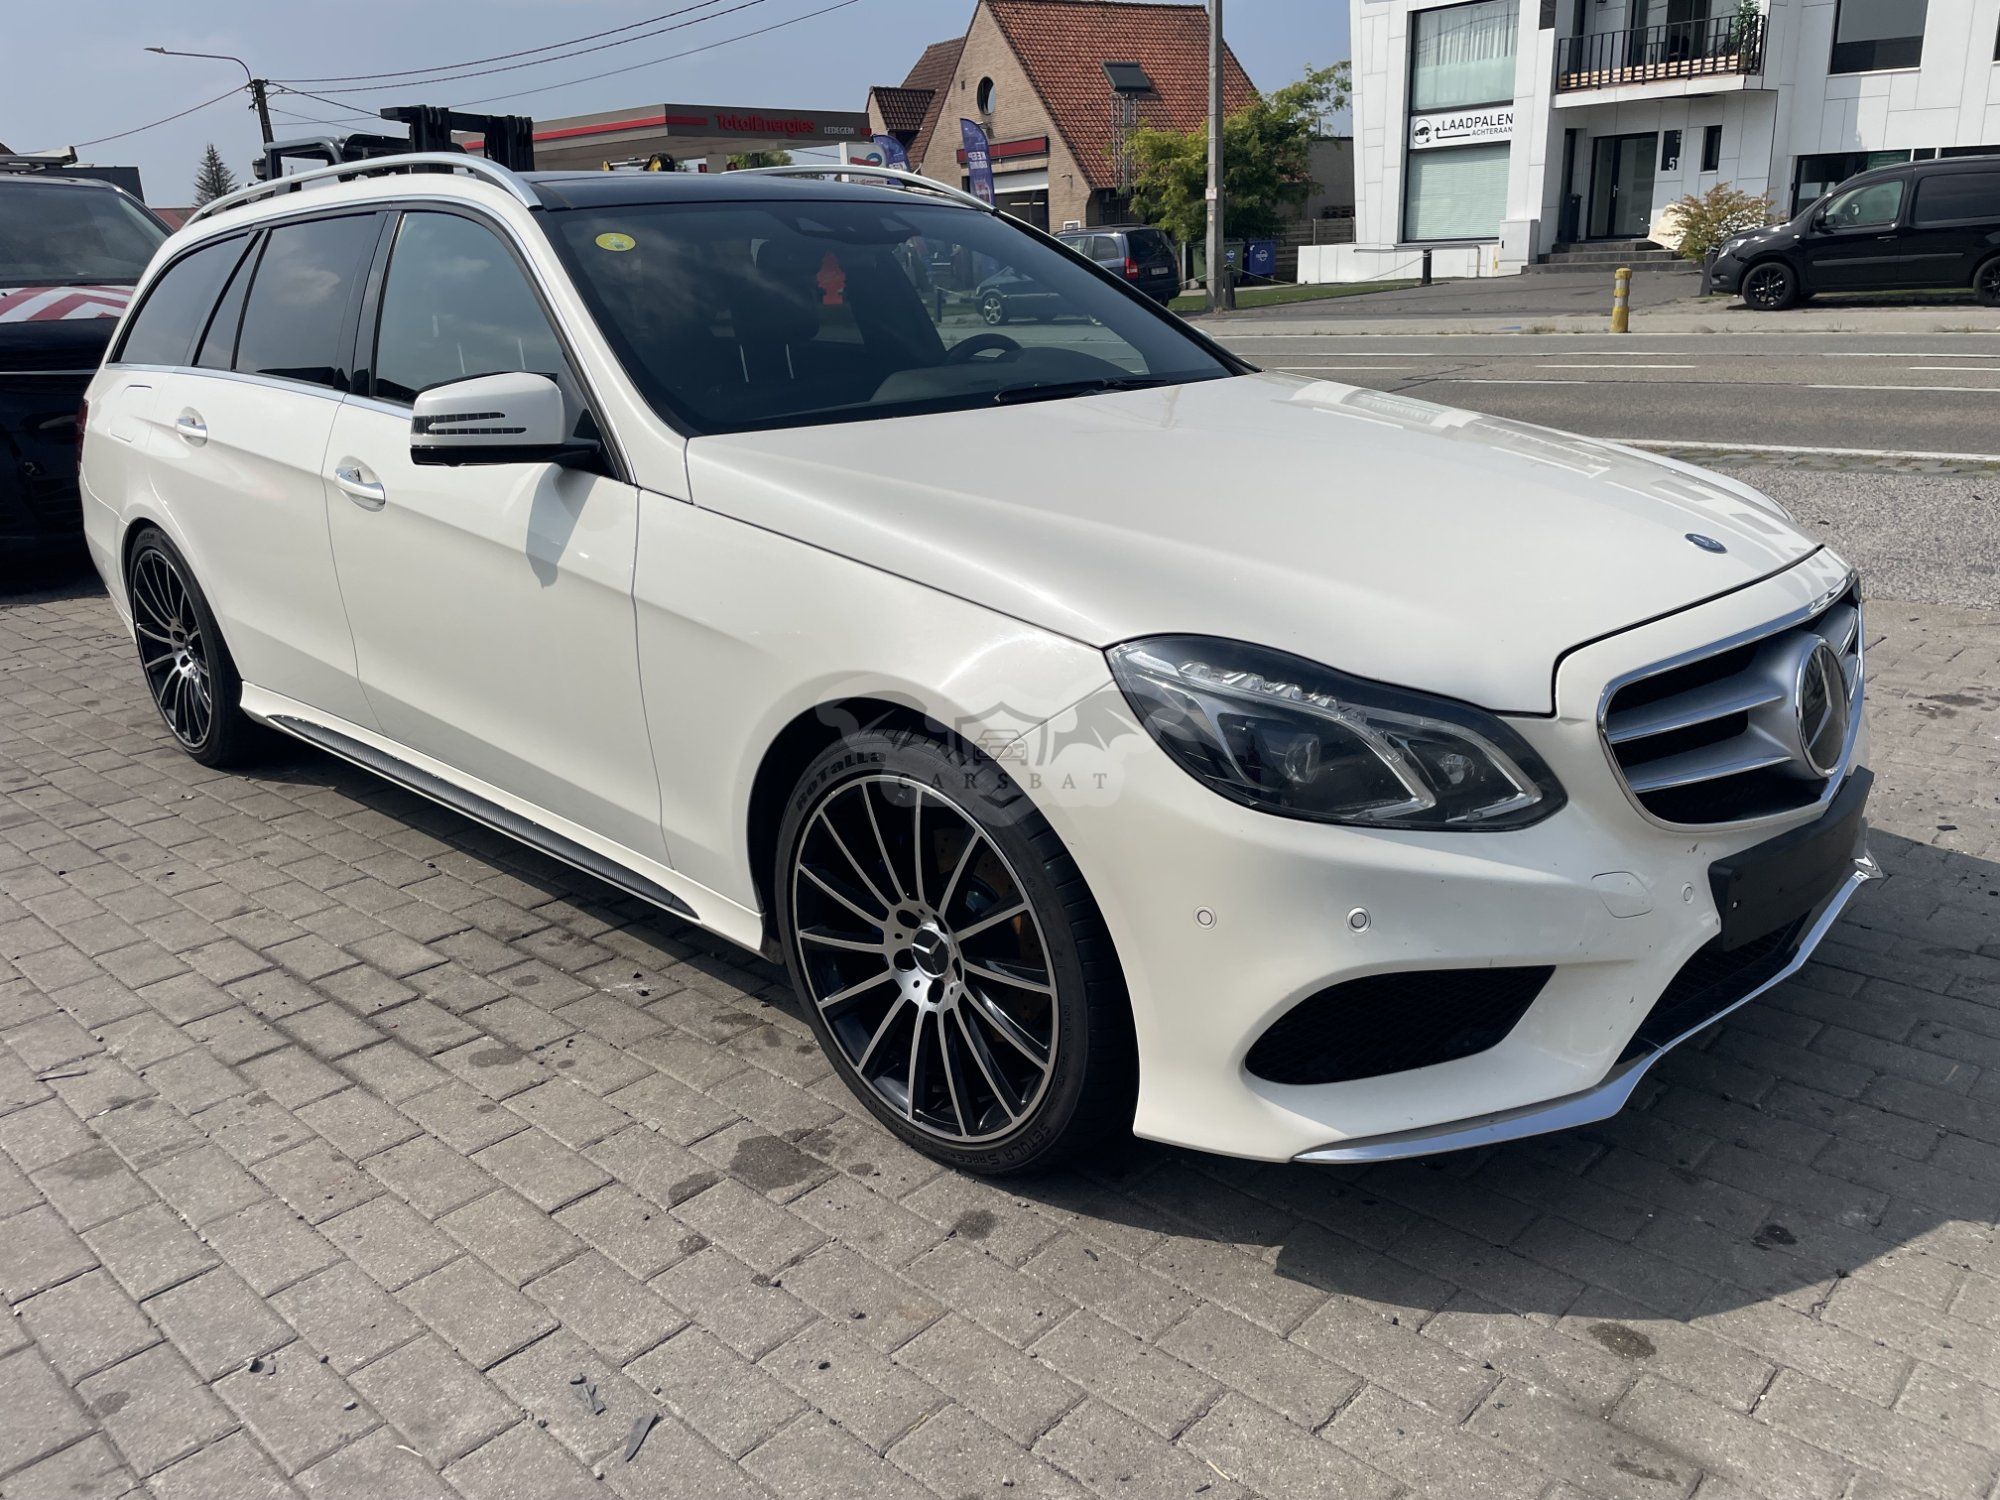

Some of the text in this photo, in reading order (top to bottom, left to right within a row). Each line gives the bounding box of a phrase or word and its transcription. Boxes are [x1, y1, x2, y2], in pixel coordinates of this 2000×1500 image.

[715, 113, 816, 137] TotalEnergies
[1442, 113, 1514, 131] LAADPALEN
[824, 126, 855, 135] LEDEGEM
[1471, 126, 1513, 136] ACHTERAAN
